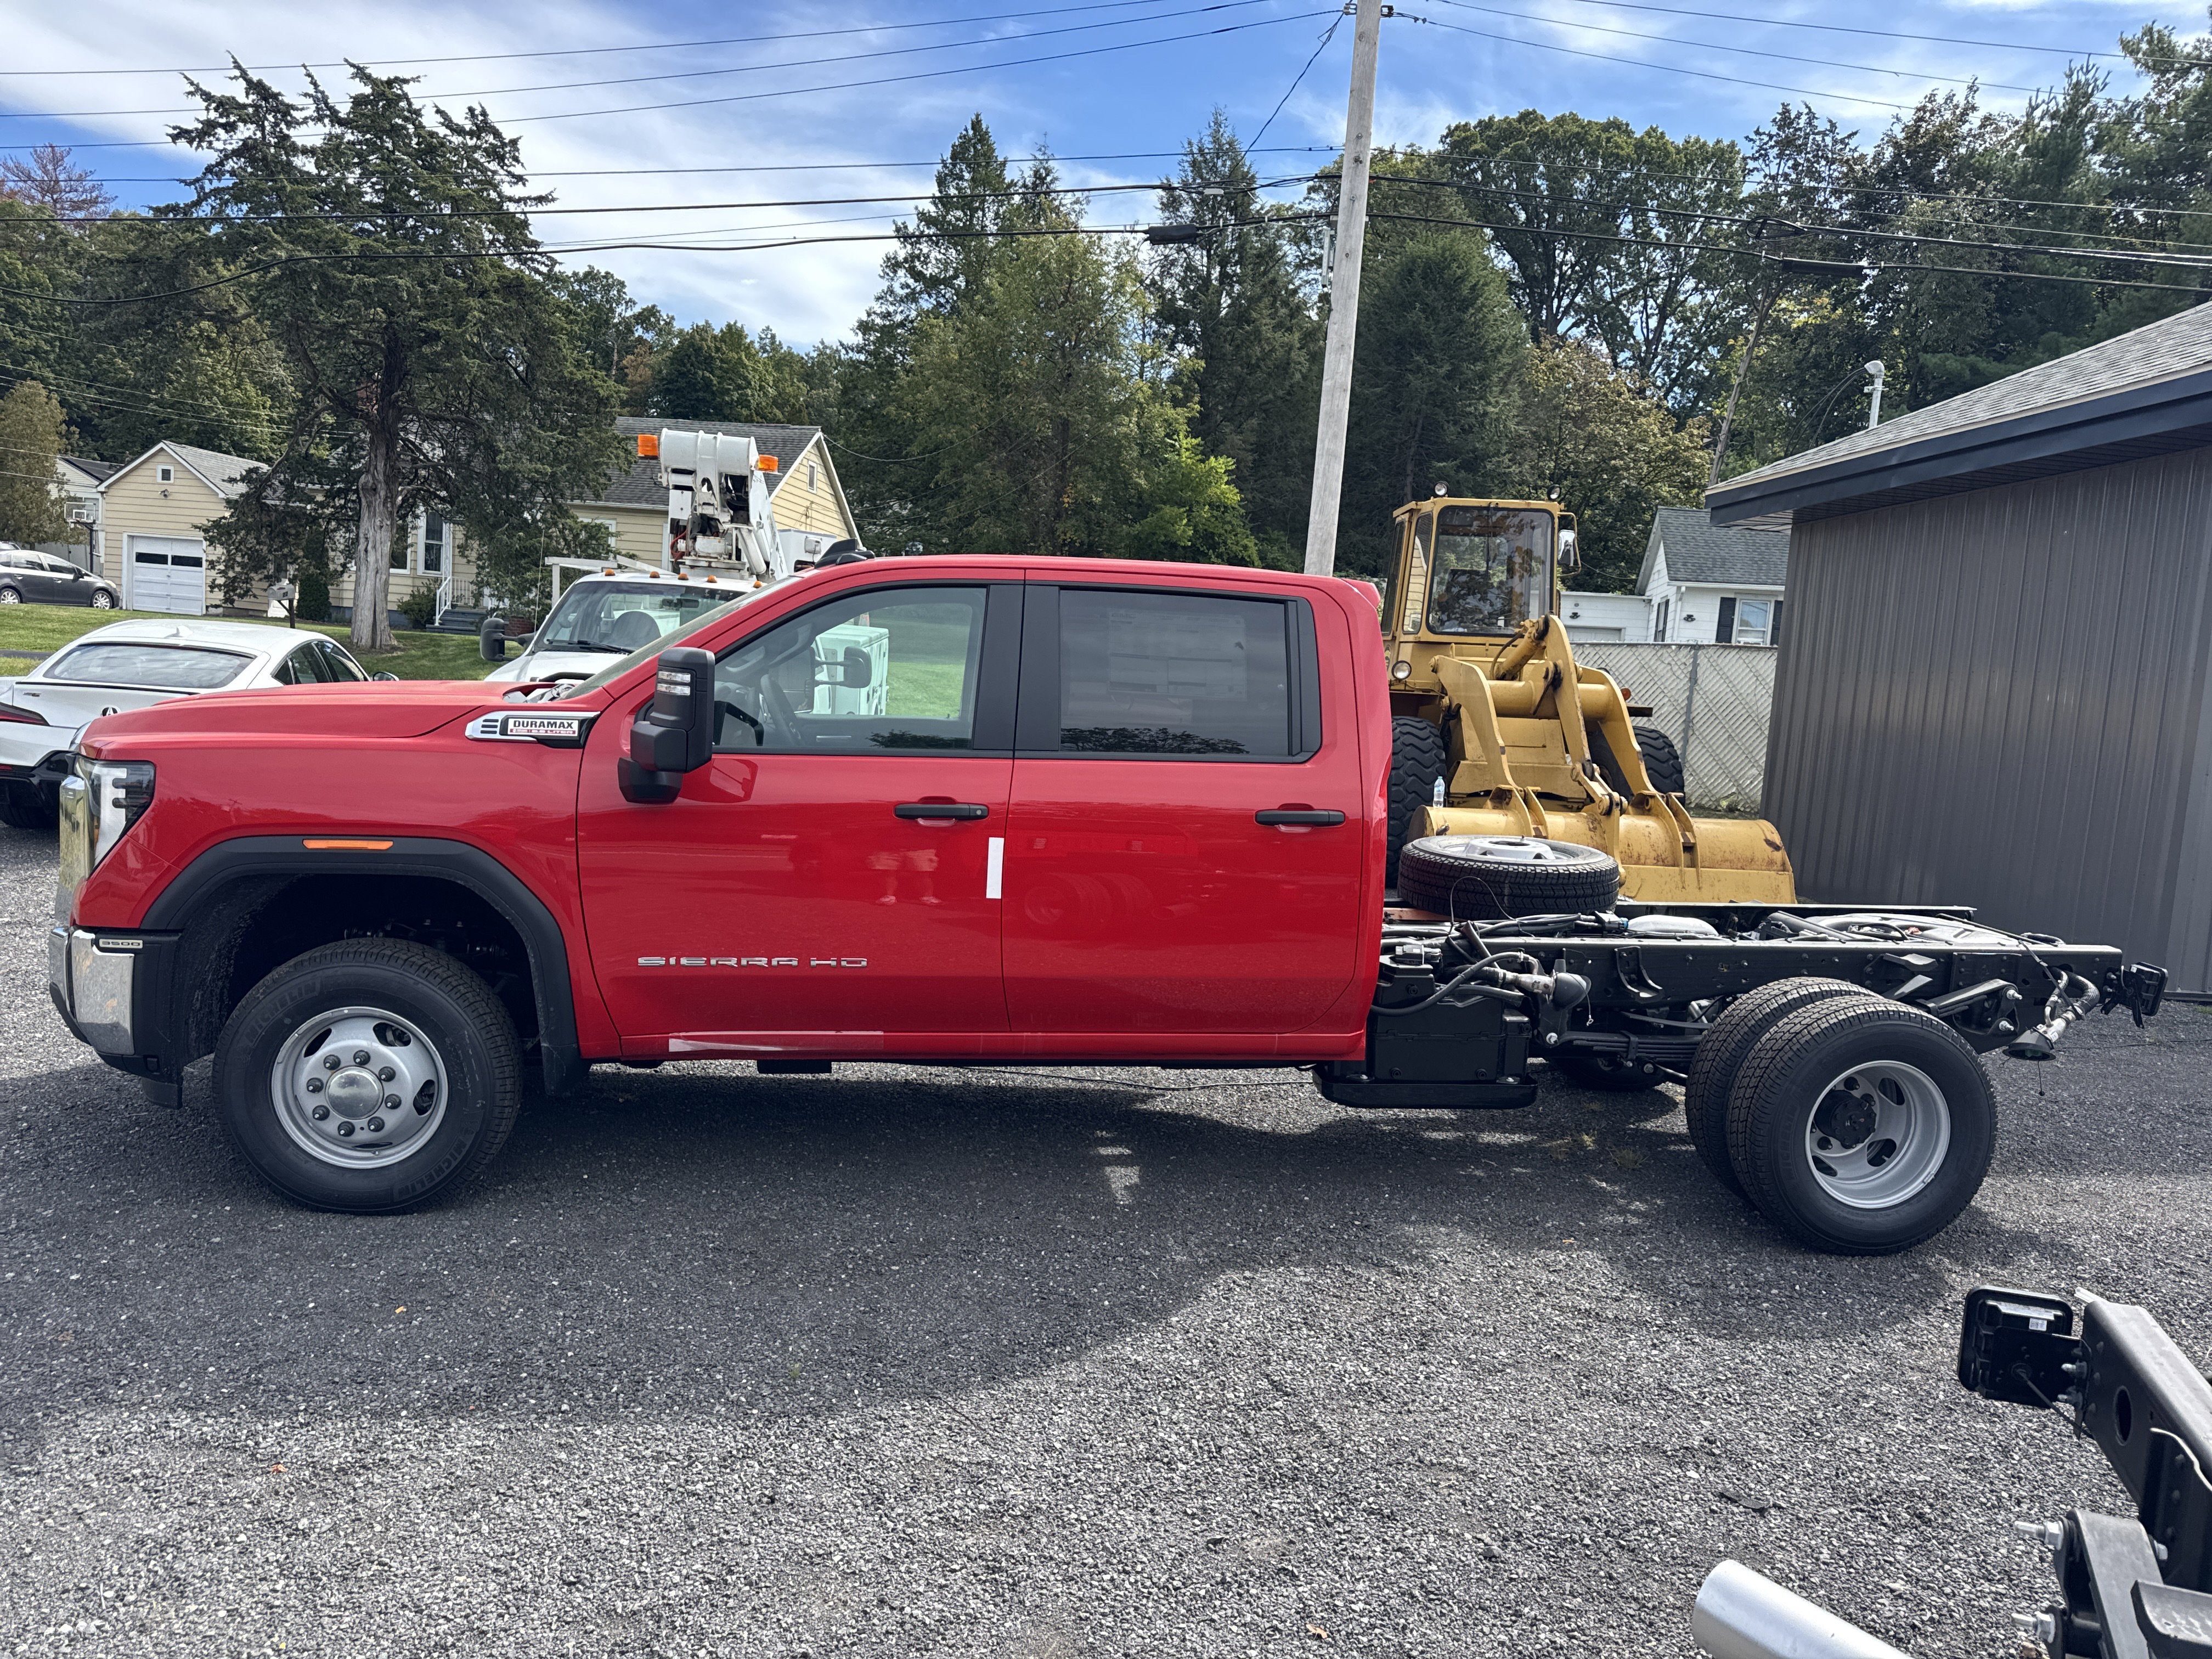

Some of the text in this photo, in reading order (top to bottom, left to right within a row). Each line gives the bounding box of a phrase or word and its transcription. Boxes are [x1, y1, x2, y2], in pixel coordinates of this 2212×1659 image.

[513, 720, 574, 729] DURAMAX
[637, 957, 867, 967] SIERRA HD
[245, 980, 317, 1043] MICHELIN
[398, 1138, 467, 1195] MICHELIN
